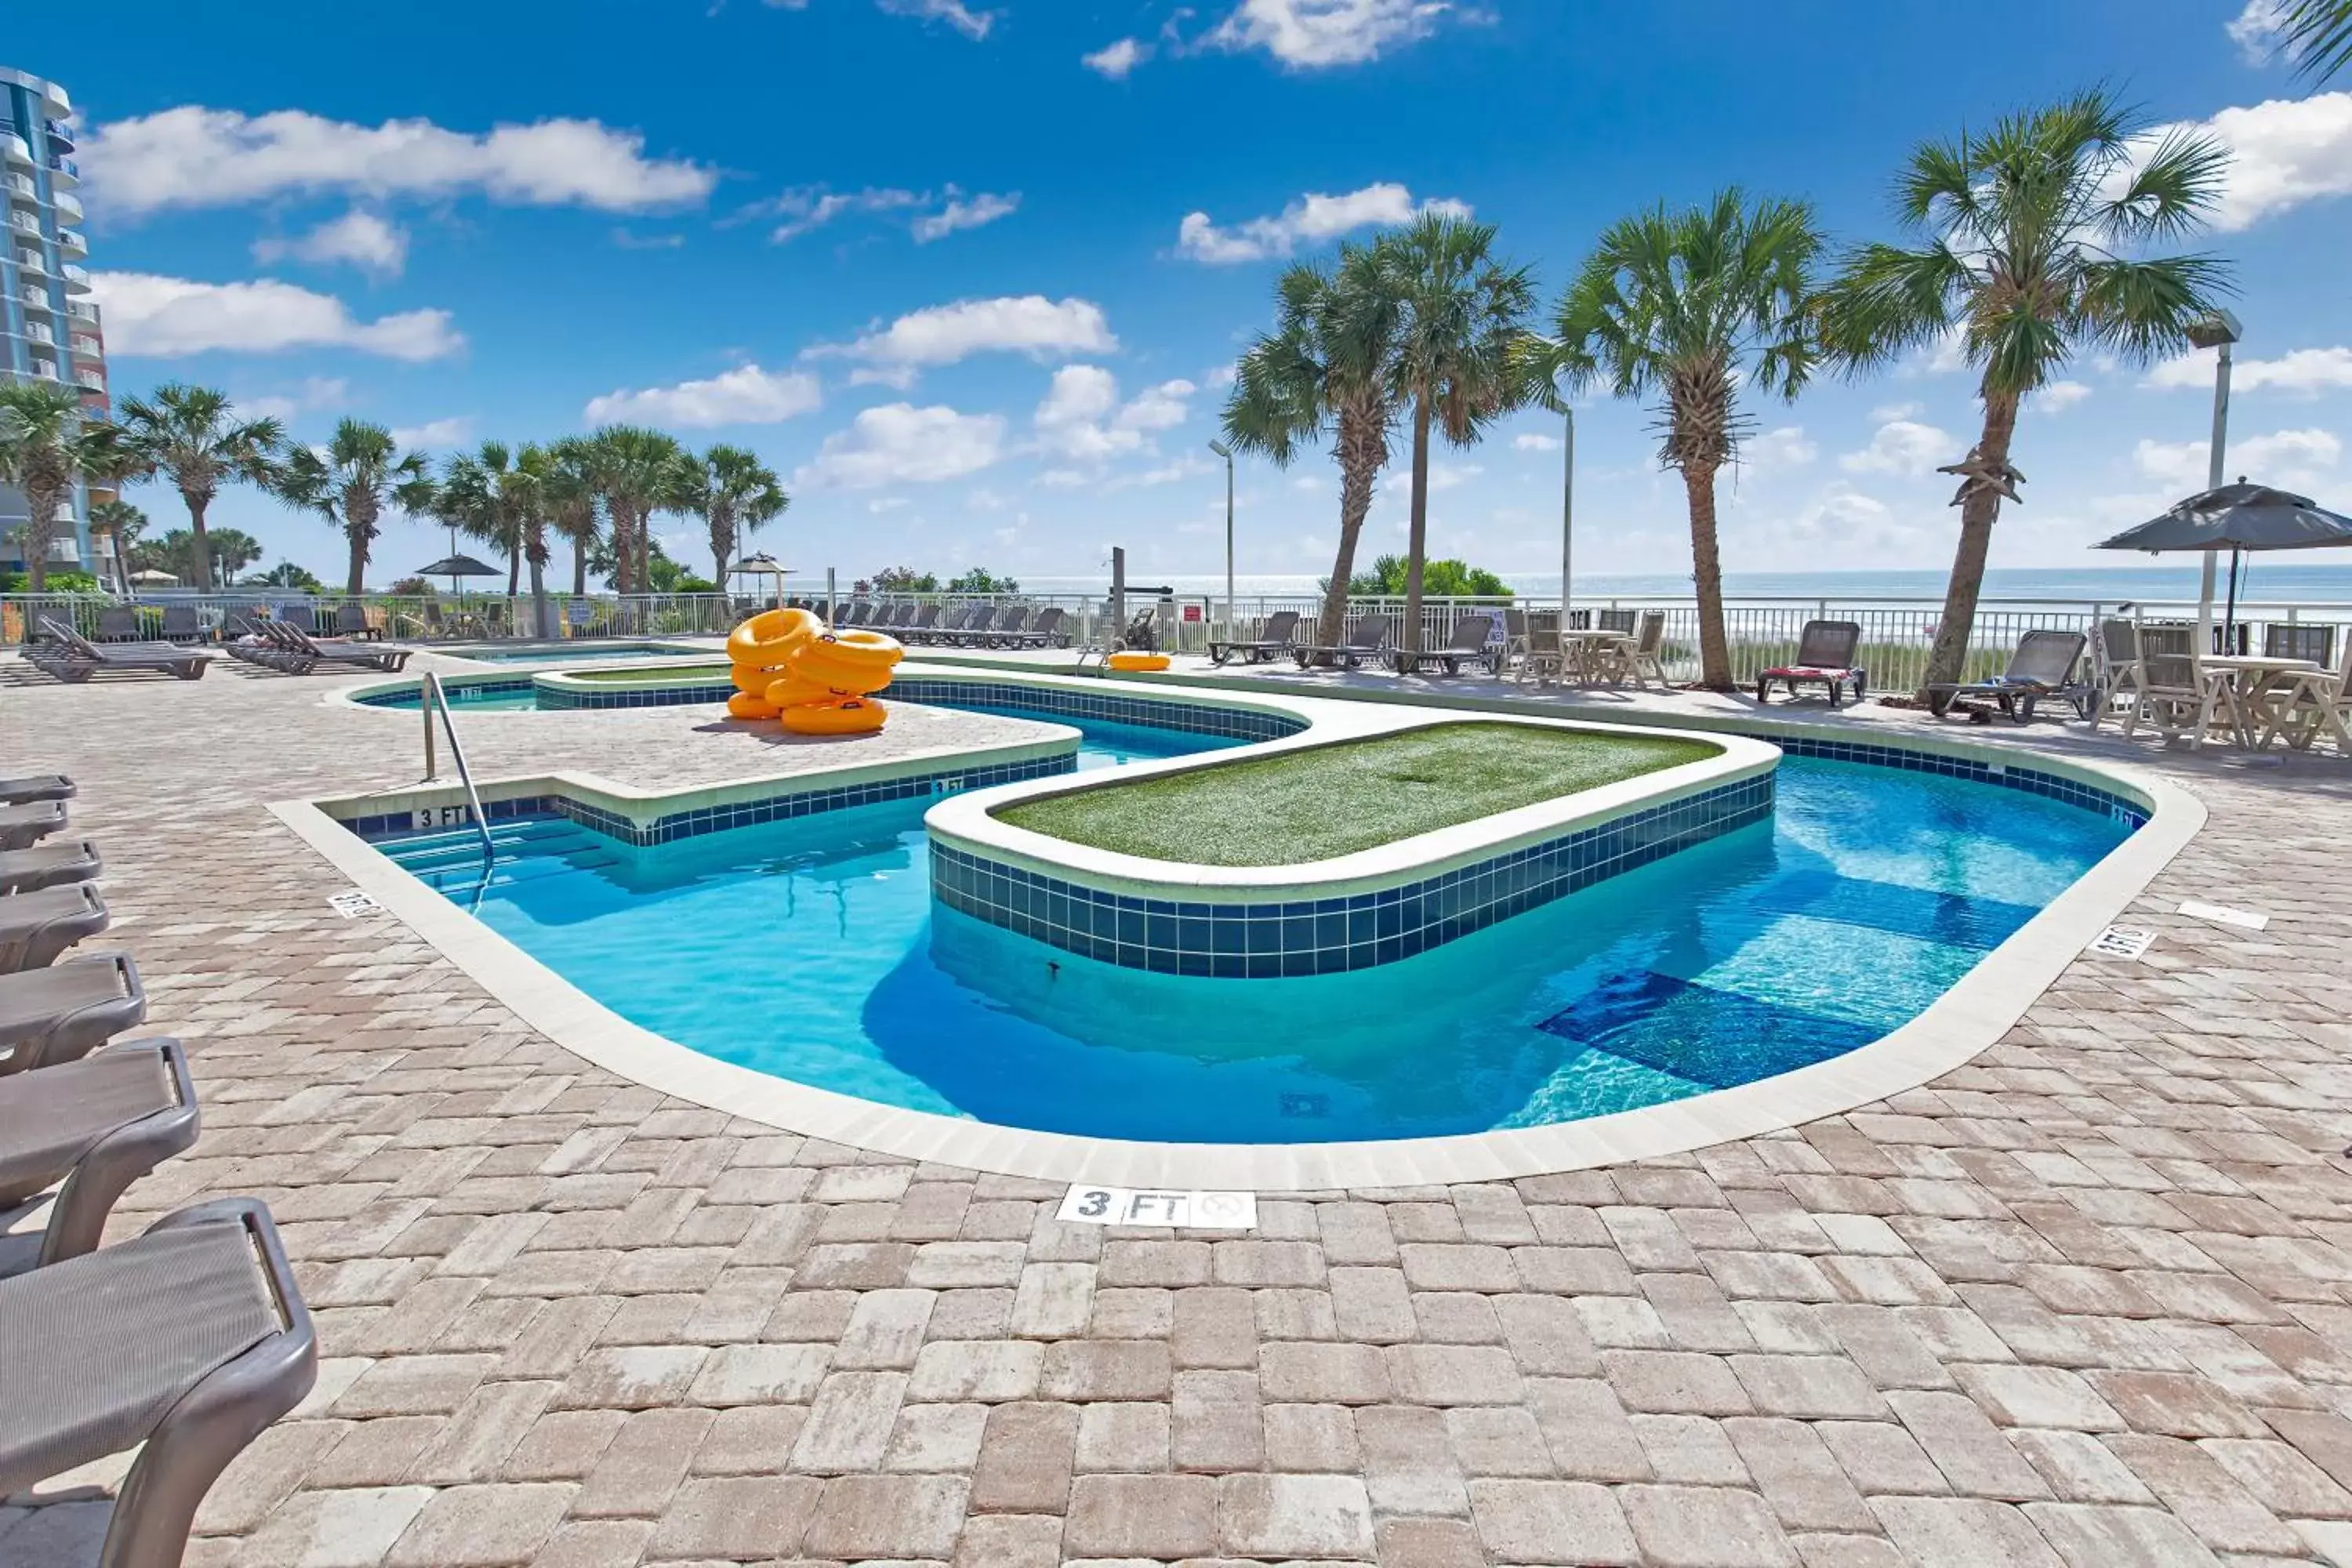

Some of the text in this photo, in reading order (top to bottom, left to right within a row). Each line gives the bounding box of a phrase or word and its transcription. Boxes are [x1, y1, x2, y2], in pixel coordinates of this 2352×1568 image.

[421, 805, 463, 827] 3 FT
[1078, 1190, 1187, 1221] 3 FT
